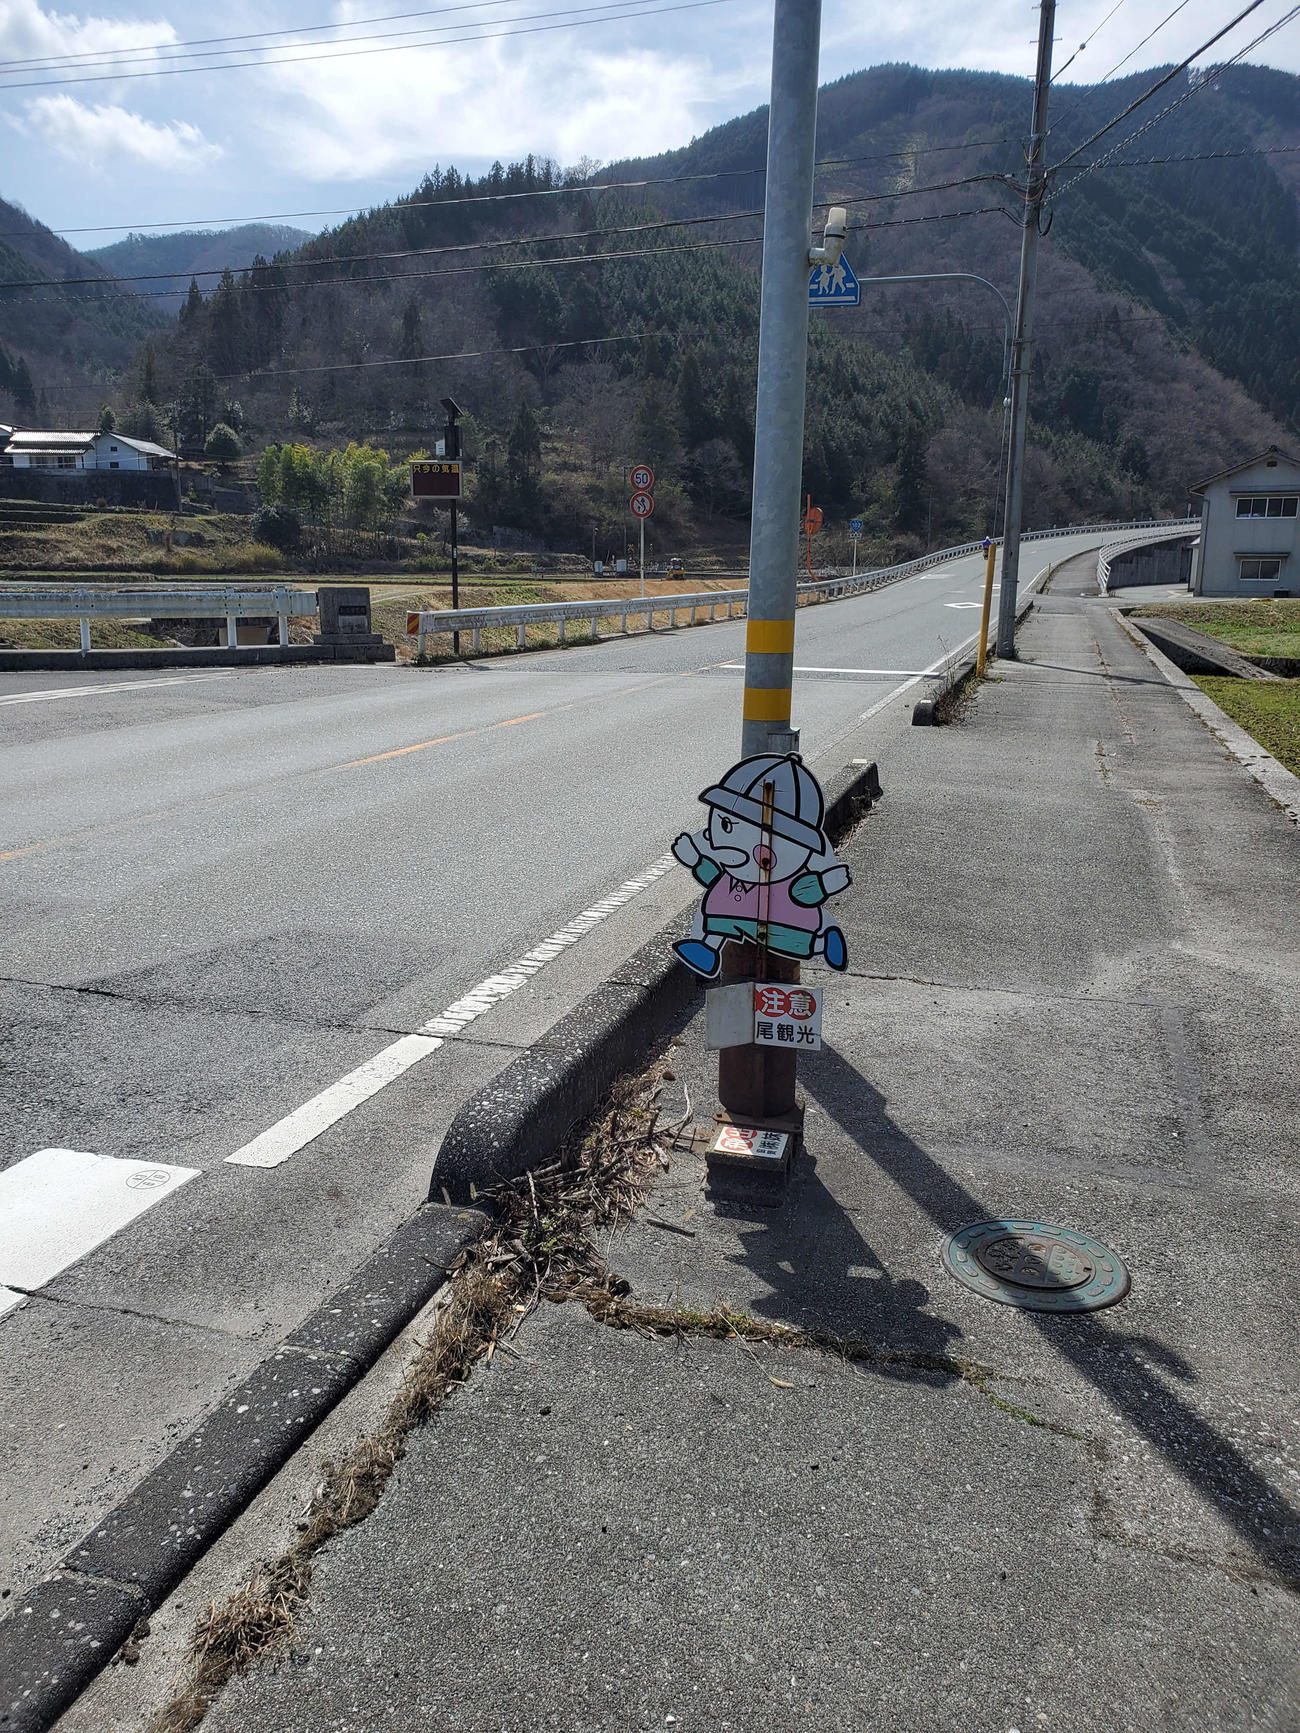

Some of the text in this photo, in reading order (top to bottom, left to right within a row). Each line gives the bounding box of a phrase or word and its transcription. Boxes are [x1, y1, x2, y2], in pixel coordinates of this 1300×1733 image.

[635, 473, 648, 484] 50
[762, 990, 811, 1016] 注意
[757, 1021, 814, 1044] 尾観光
